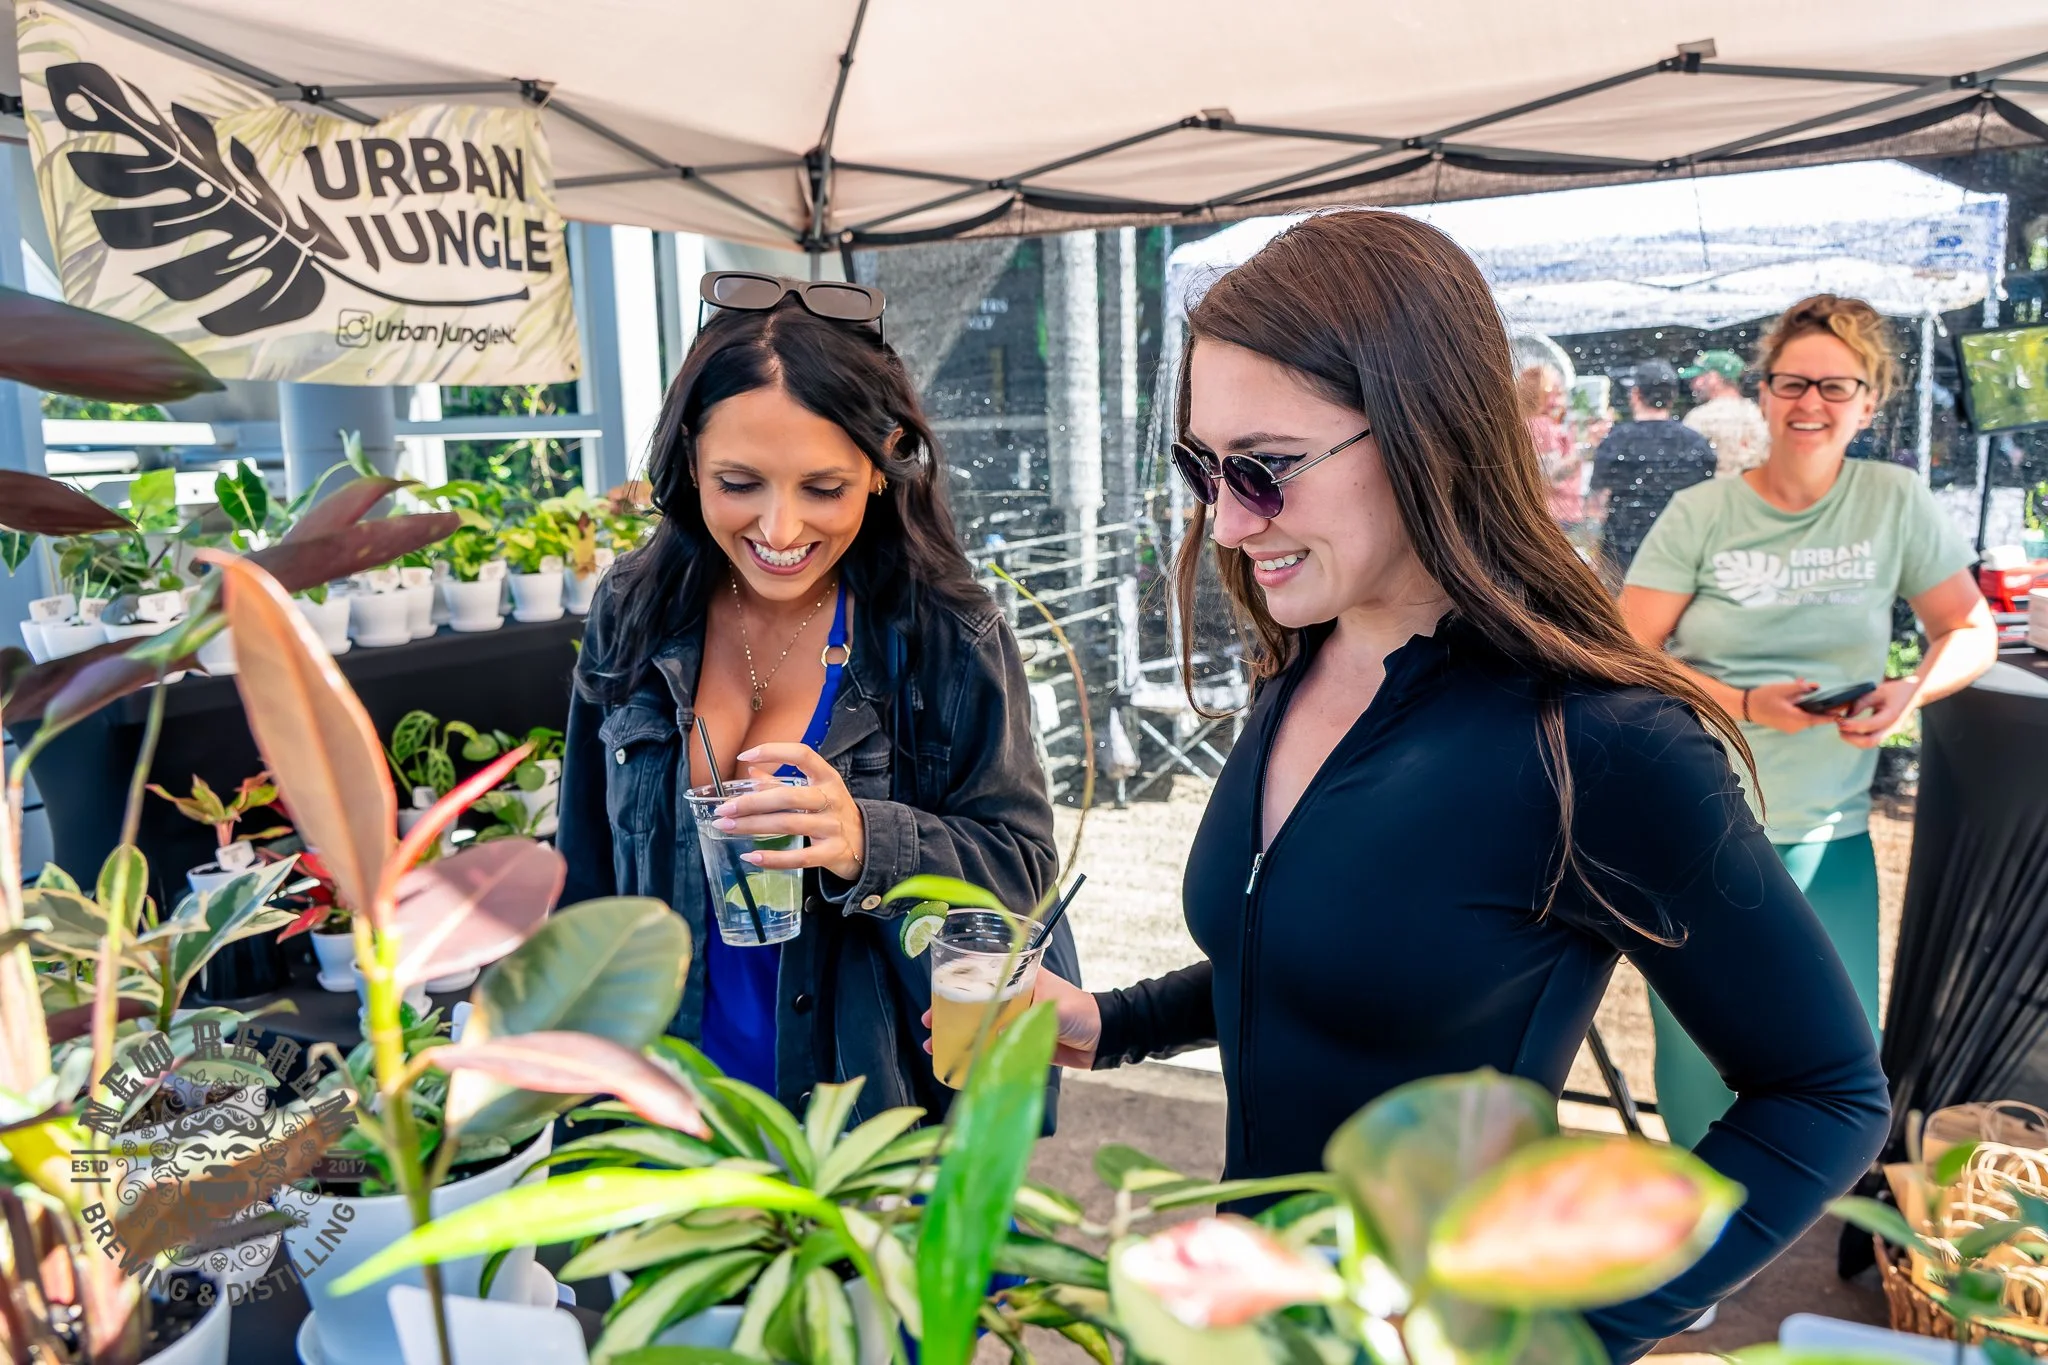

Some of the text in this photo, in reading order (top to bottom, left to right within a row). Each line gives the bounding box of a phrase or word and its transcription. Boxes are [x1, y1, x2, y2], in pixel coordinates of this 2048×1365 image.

[303, 138, 525, 201] URBAN
[346, 210, 552, 272] JUNGLE
[1790, 540, 1872, 567] URBAN
[1790, 561, 1877, 589] JUNGLE
